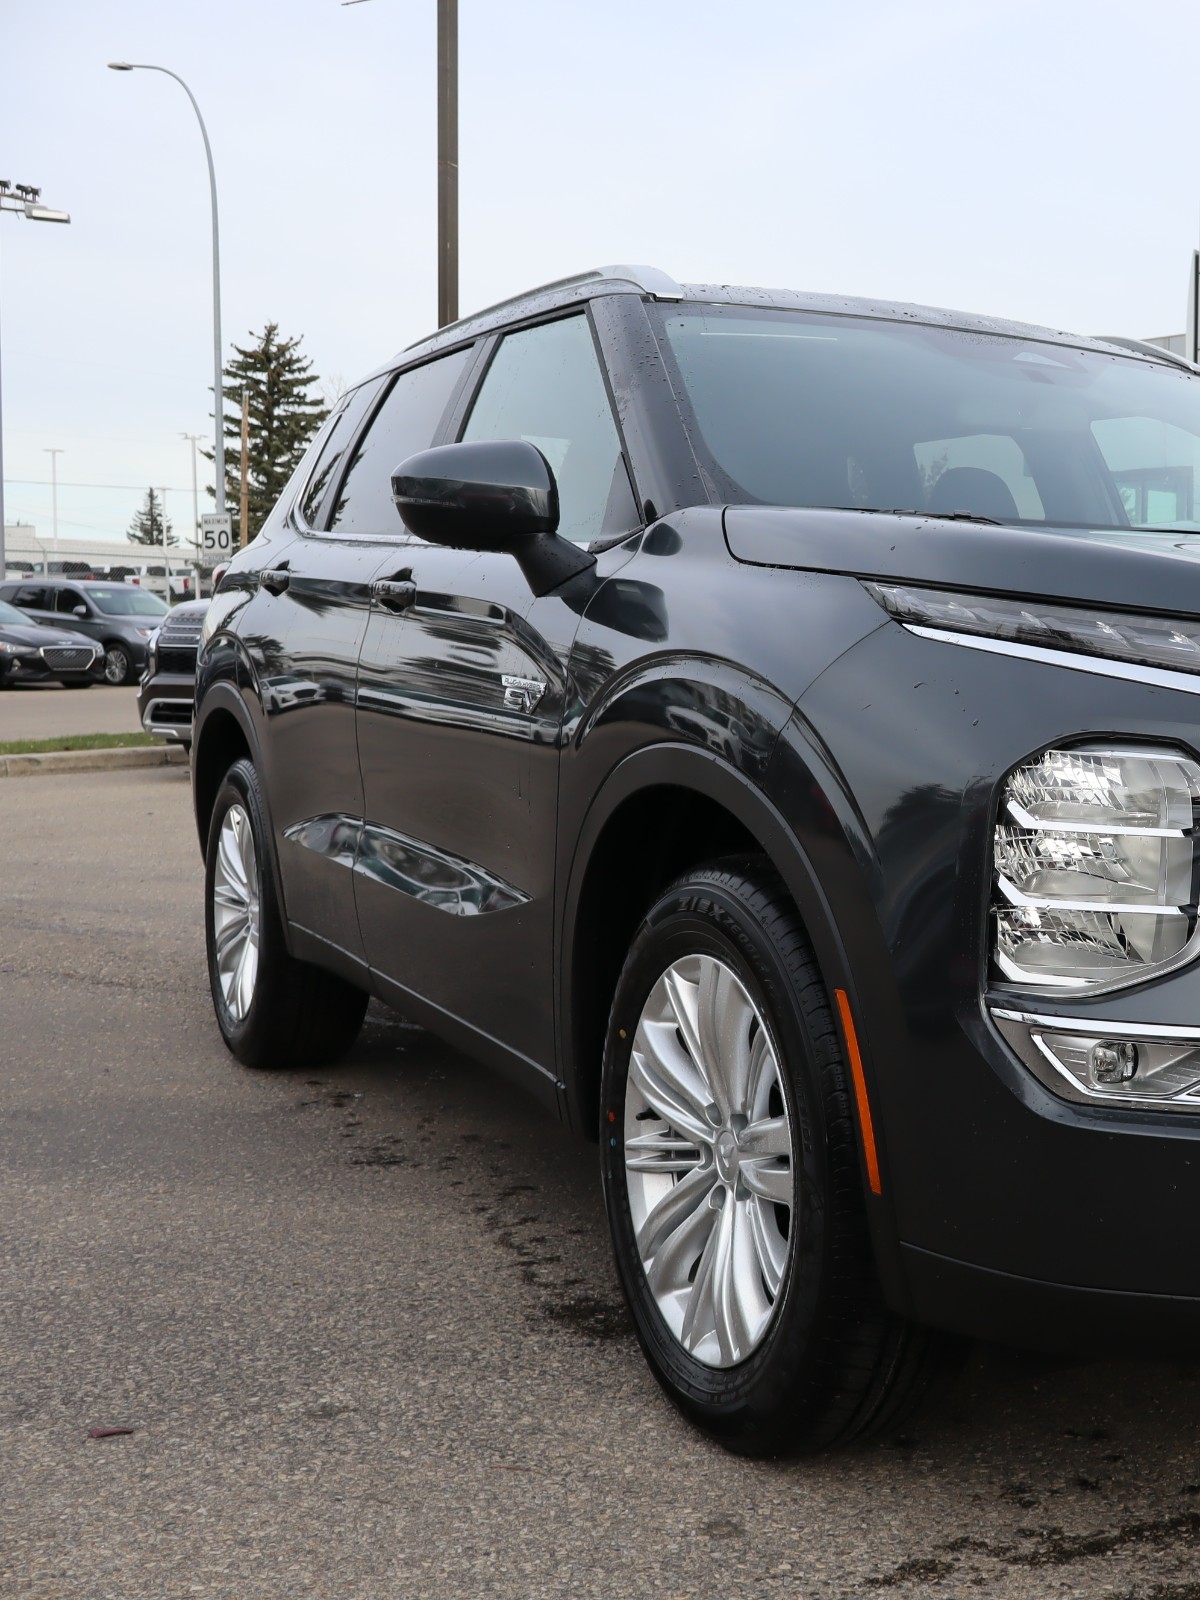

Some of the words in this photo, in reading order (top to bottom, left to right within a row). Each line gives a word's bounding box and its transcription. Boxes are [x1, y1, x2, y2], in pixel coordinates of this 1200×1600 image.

[204, 529, 230, 550] 50
[503, 687, 542, 714] EV
[676, 896, 726, 923] ZIEX
